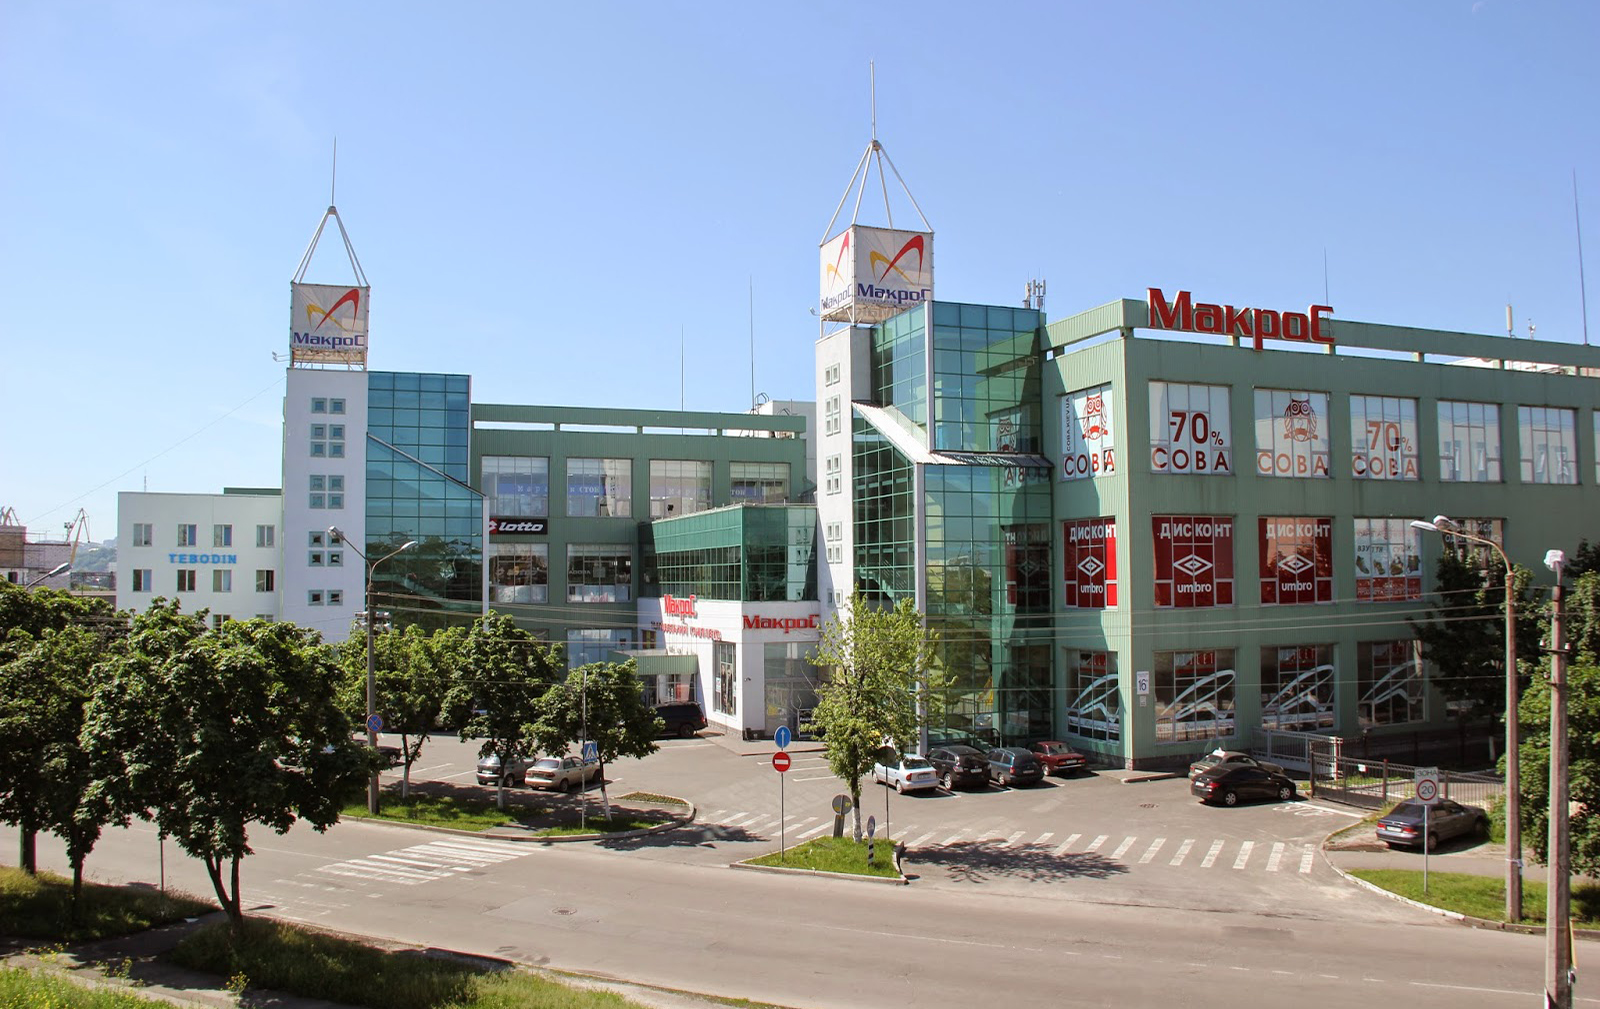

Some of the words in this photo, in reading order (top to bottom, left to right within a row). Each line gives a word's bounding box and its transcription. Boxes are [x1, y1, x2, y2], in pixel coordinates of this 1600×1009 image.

[858, 283, 931, 304] МакроС
[1147, 287, 1335, 351] МакроС
[293, 332, 365, 349] МакроС
[1170, 411, 1224, 446] -70%
[1064, 449, 1115, 476] СОВА
[1151, 447, 1229, 471] СОВА
[1257, 452, 1328, 475] СОВА
[1352, 455, 1418, 477] СОВА
[498, 521, 544, 532] lotto
[1070, 524, 1116, 542] ДИСКОНТ
[1160, 523, 1232, 540] ДИСКОНТ
[1266, 524, 1330, 540] ДИСКОНТ
[169, 553, 237, 564] TEBODIN
[1080, 584, 1103, 594] umbro
[1177, 581, 1211, 593] umbro
[1281, 580, 1312, 592] umbro
[743, 614, 820, 633] МакроС
[1421, 785, 1434, 794] 20
